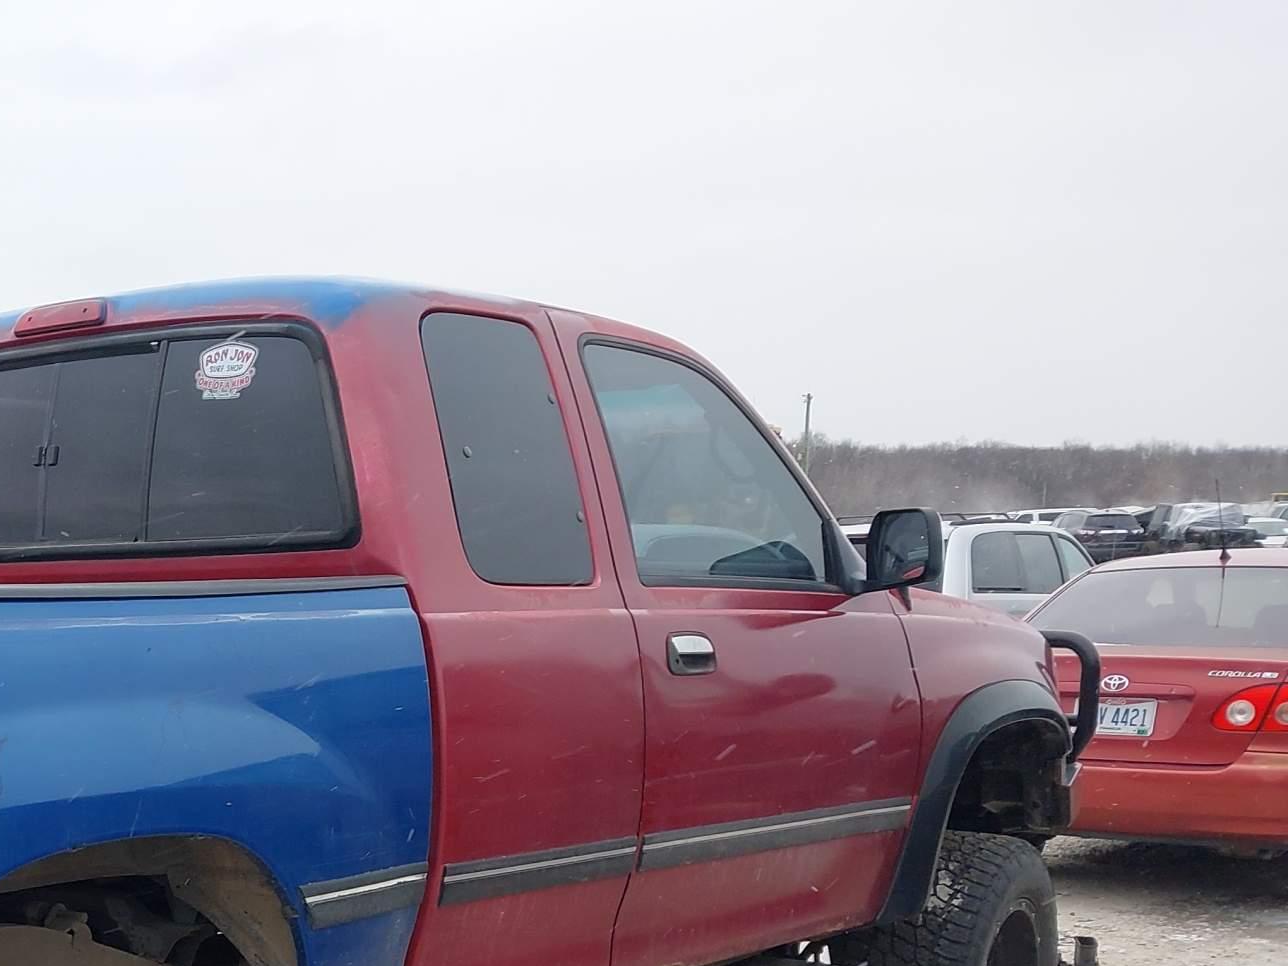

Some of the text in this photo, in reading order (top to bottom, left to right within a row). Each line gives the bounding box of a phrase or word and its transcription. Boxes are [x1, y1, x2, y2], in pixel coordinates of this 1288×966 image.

[206, 349, 253, 366] RON JON
[227, 364, 243, 373] SHOP
[1208, 670, 1261, 678] COROLLA
[1111, 708, 1147, 727] 4421
